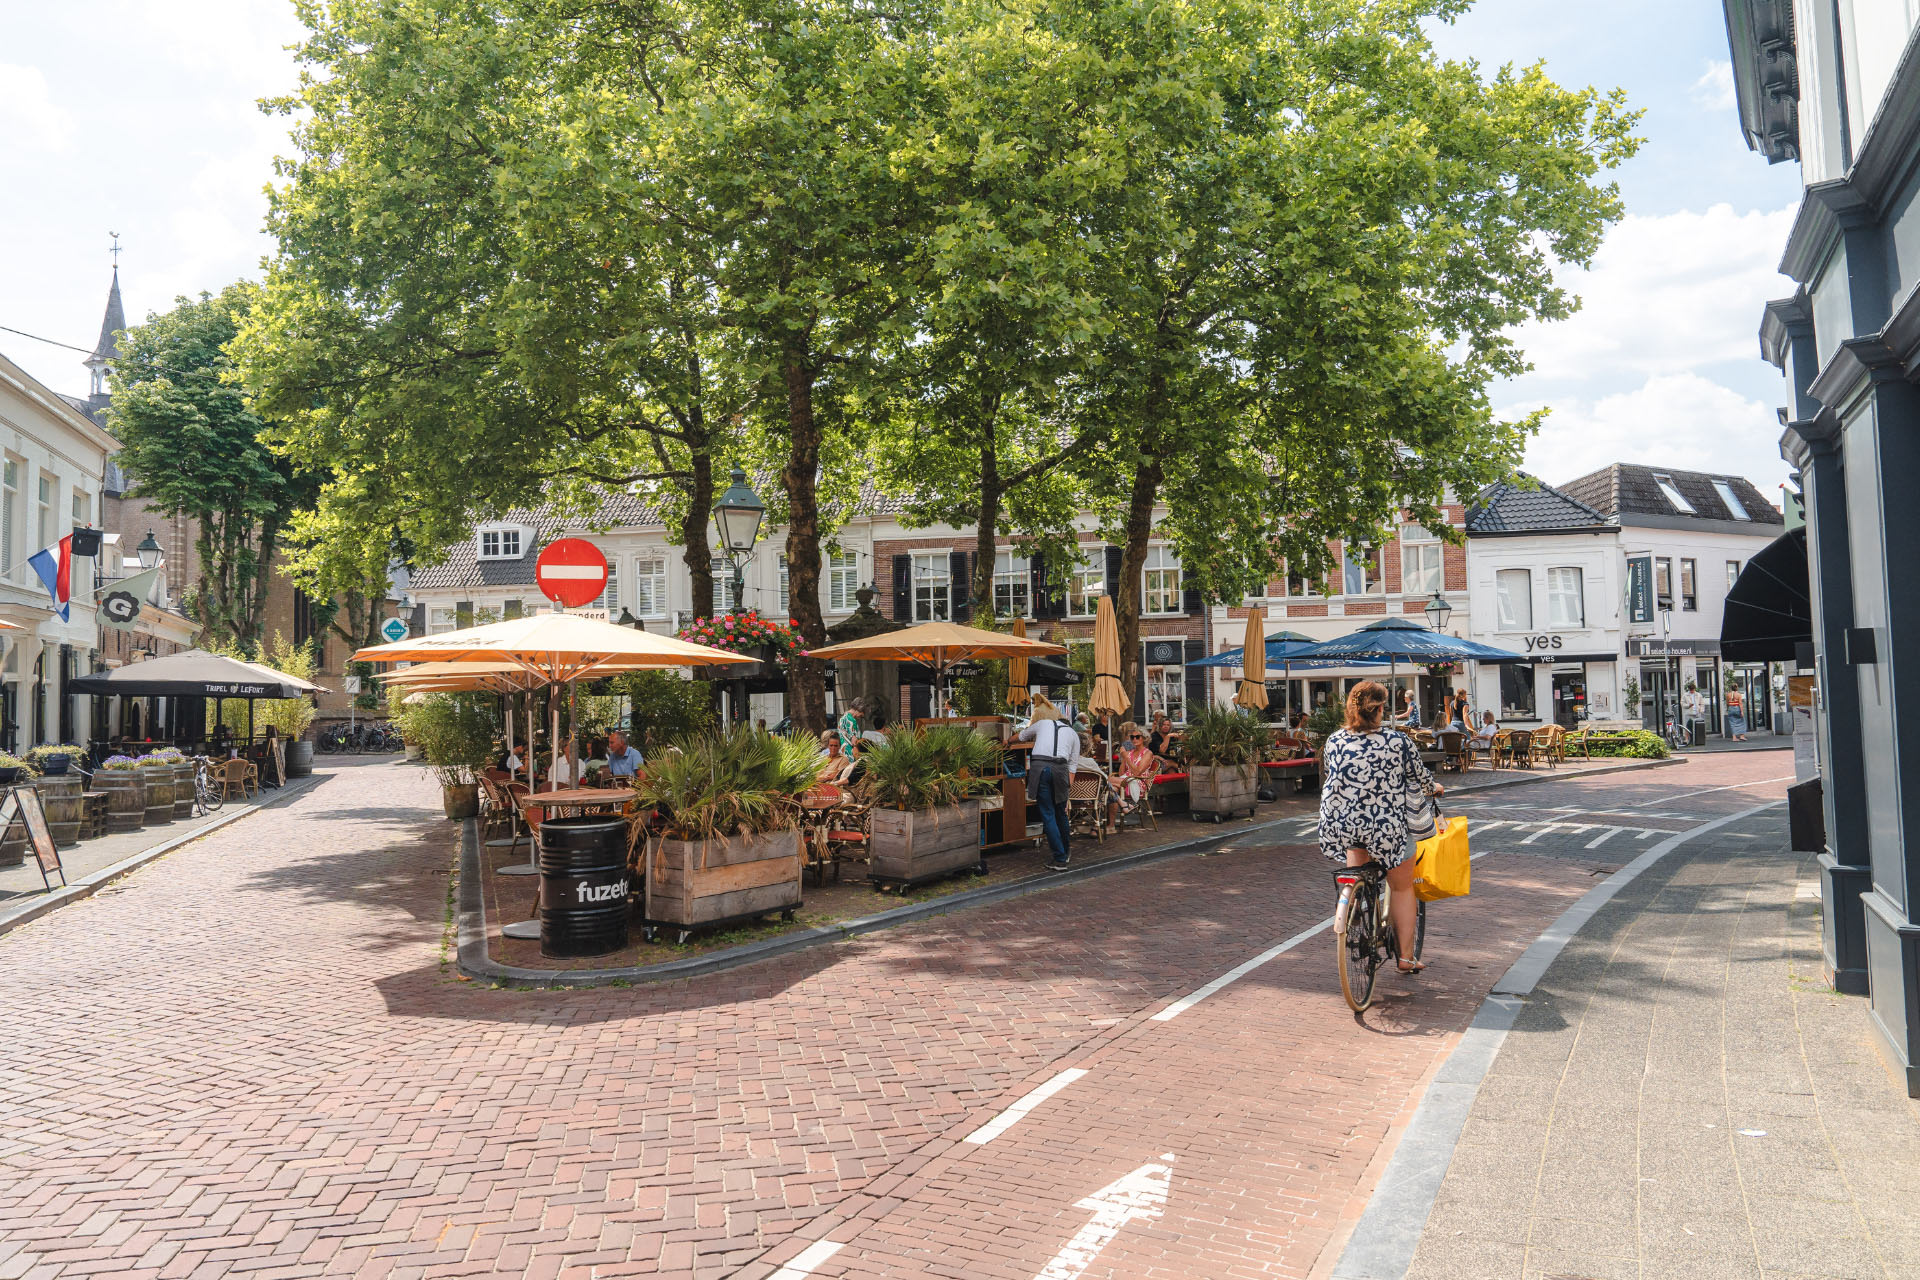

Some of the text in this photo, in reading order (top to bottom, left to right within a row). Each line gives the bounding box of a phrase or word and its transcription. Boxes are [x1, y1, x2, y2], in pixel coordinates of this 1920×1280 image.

[109, 598, 132, 617] G
[1525, 635, 1563, 652] yes
[1540, 655, 1555, 663] yes
[205, 684, 228, 692] TRIPEL
